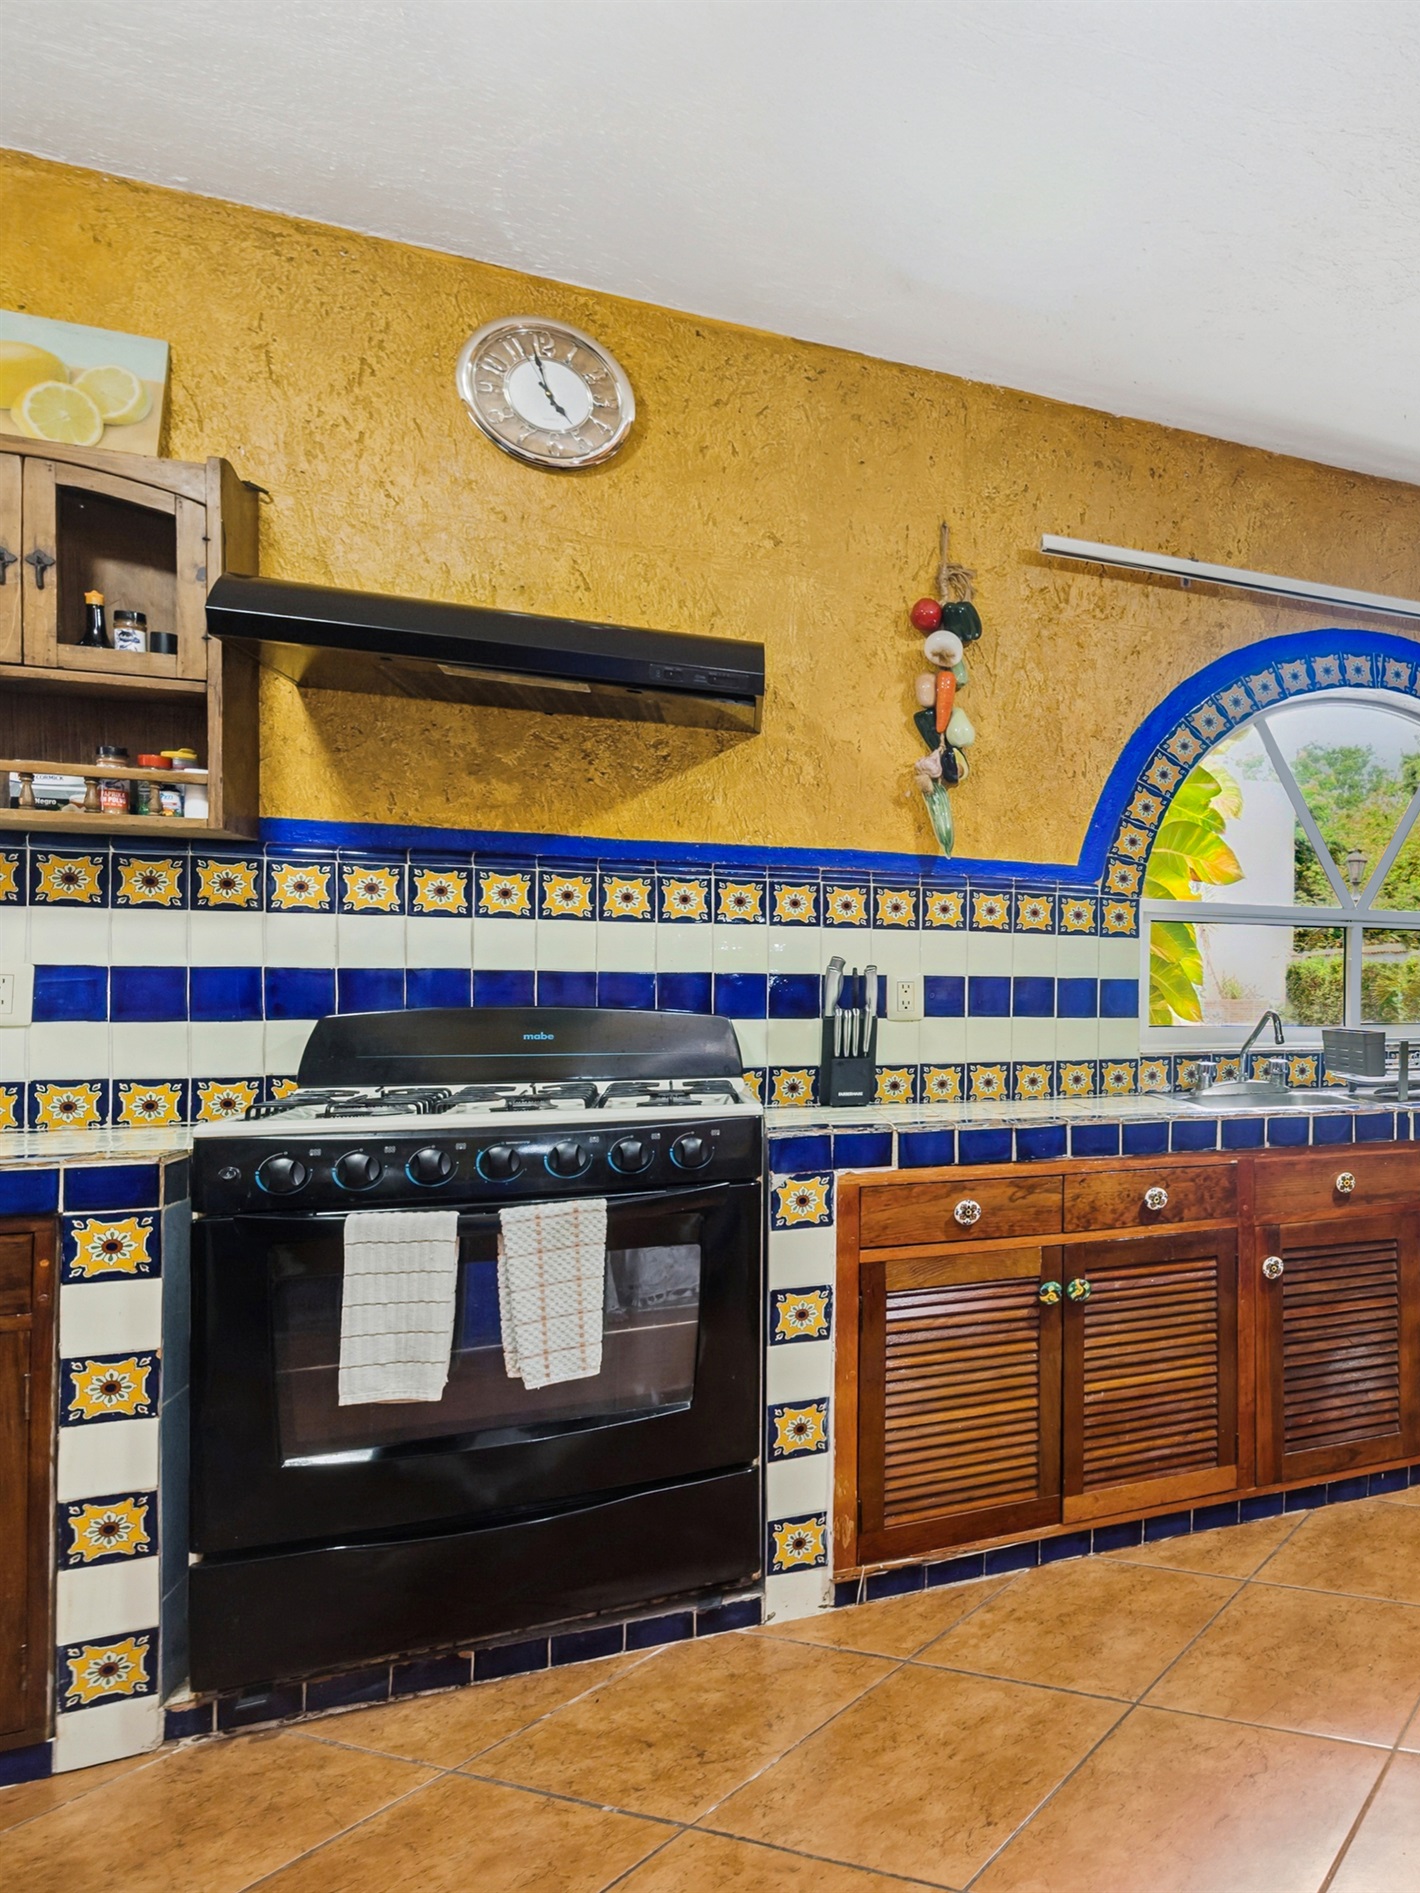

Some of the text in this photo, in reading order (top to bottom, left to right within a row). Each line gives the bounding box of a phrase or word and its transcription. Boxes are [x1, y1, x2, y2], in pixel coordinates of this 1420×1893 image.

[531, 331, 556, 358] 12
[564, 343, 578, 366] 1
[35, 798, 57, 806] Negro
[523, 1031, 555, 1040] mabe
